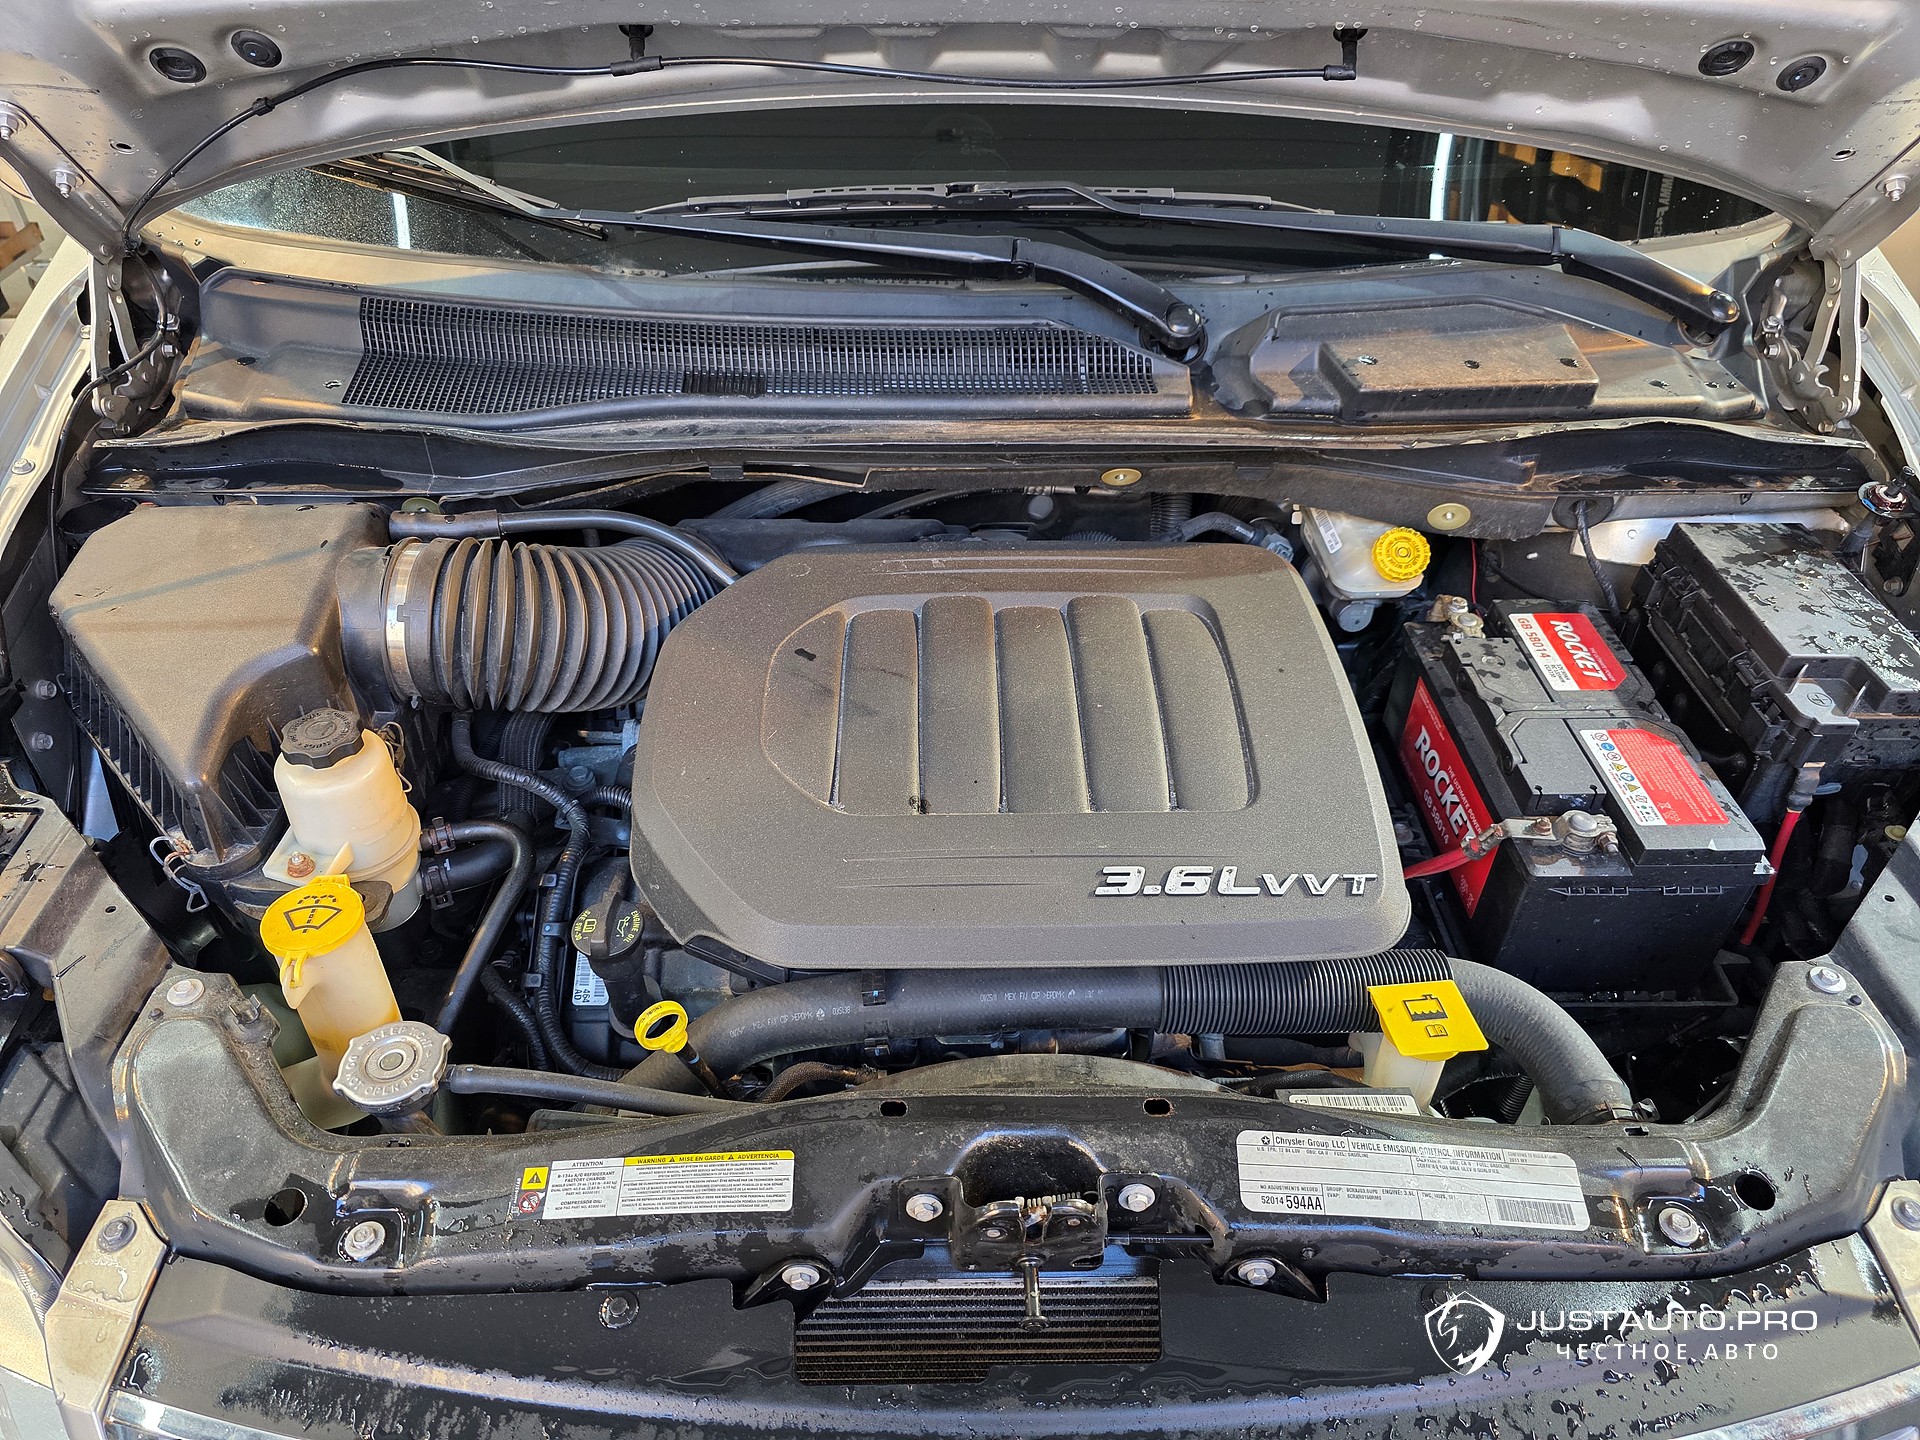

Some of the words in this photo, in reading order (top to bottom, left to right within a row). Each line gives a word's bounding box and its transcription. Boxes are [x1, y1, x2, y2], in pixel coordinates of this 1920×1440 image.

[1517, 617, 1533, 630] GB
[1526, 631, 1552, 659] 58014
[1549, 620, 1609, 682] ROCKET
[1415, 725, 1478, 844] ROCKET
[1447, 765, 1456, 780] THE
[1453, 777, 1471, 809] ULTIMATE
[1467, 806, 1482, 835] POWER
[1423, 788, 1433, 808] GB
[1430, 804, 1449, 845] 58014
[631, 910, 642, 933] ENGINE
[623, 934, 635, 943] OIL
[574, 988, 583, 1001] AD
[582, 988, 591, 1003] 464
[371, 1026, 408, 1042] KEEP
[364, 1084, 400, 1096] OPEN
[1275, 1136, 1306, 1146] Chrysler
[1307, 1138, 1330, 1149] Group
[1332, 1140, 1346, 1149] LLC
[1351, 1141, 1381, 1152] VEHICLE
[1383, 1143, 1417, 1154] EMISSION
[1418, 1146, 1451, 1157] CONTROL
[1452, 1149, 1502, 1161] INFORMATION
[1261, 1196, 1284, 1205] 52014
[1285, 1195, 1323, 1211] 594AA
